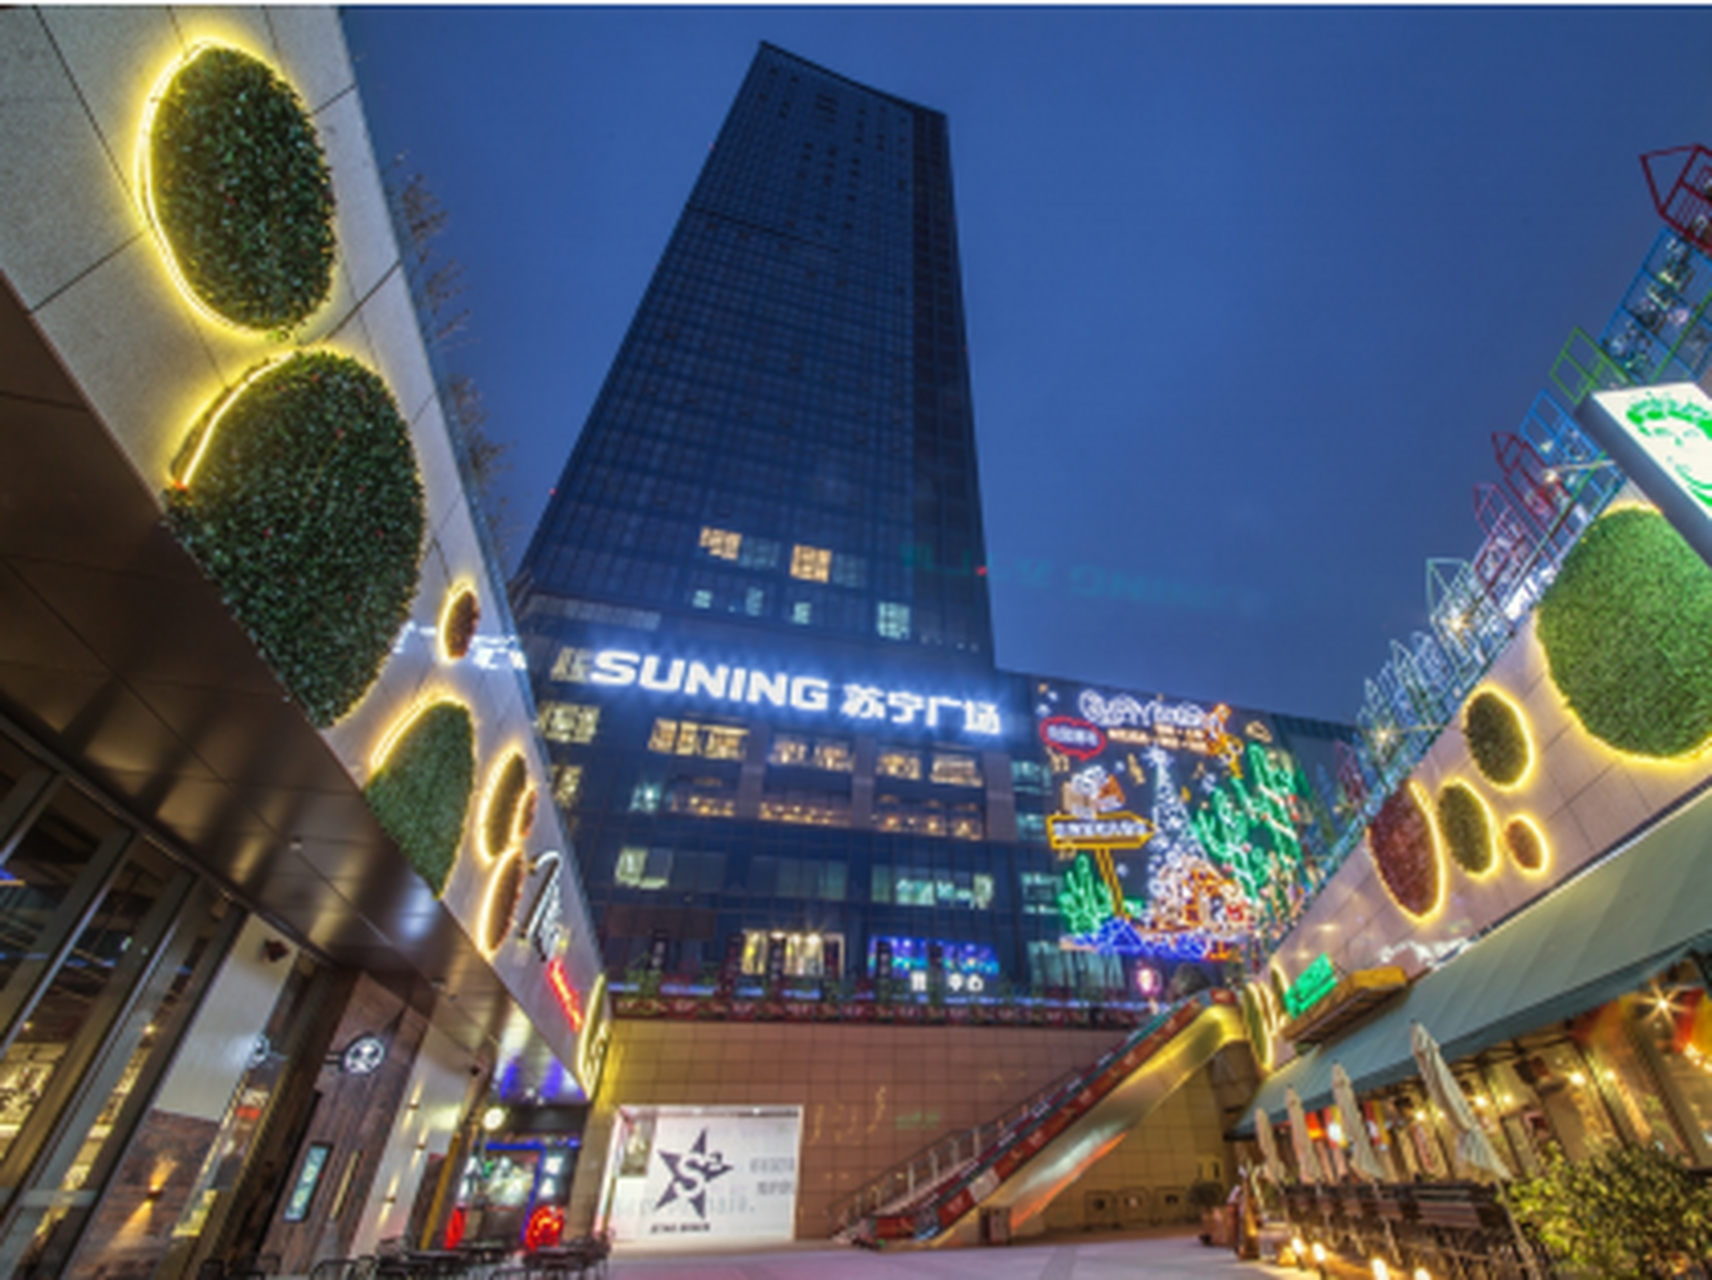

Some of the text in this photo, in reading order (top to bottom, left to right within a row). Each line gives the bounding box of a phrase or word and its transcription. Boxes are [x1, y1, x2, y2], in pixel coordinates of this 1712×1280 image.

[591, 651, 1001, 734] SUNING 苏宁广场
